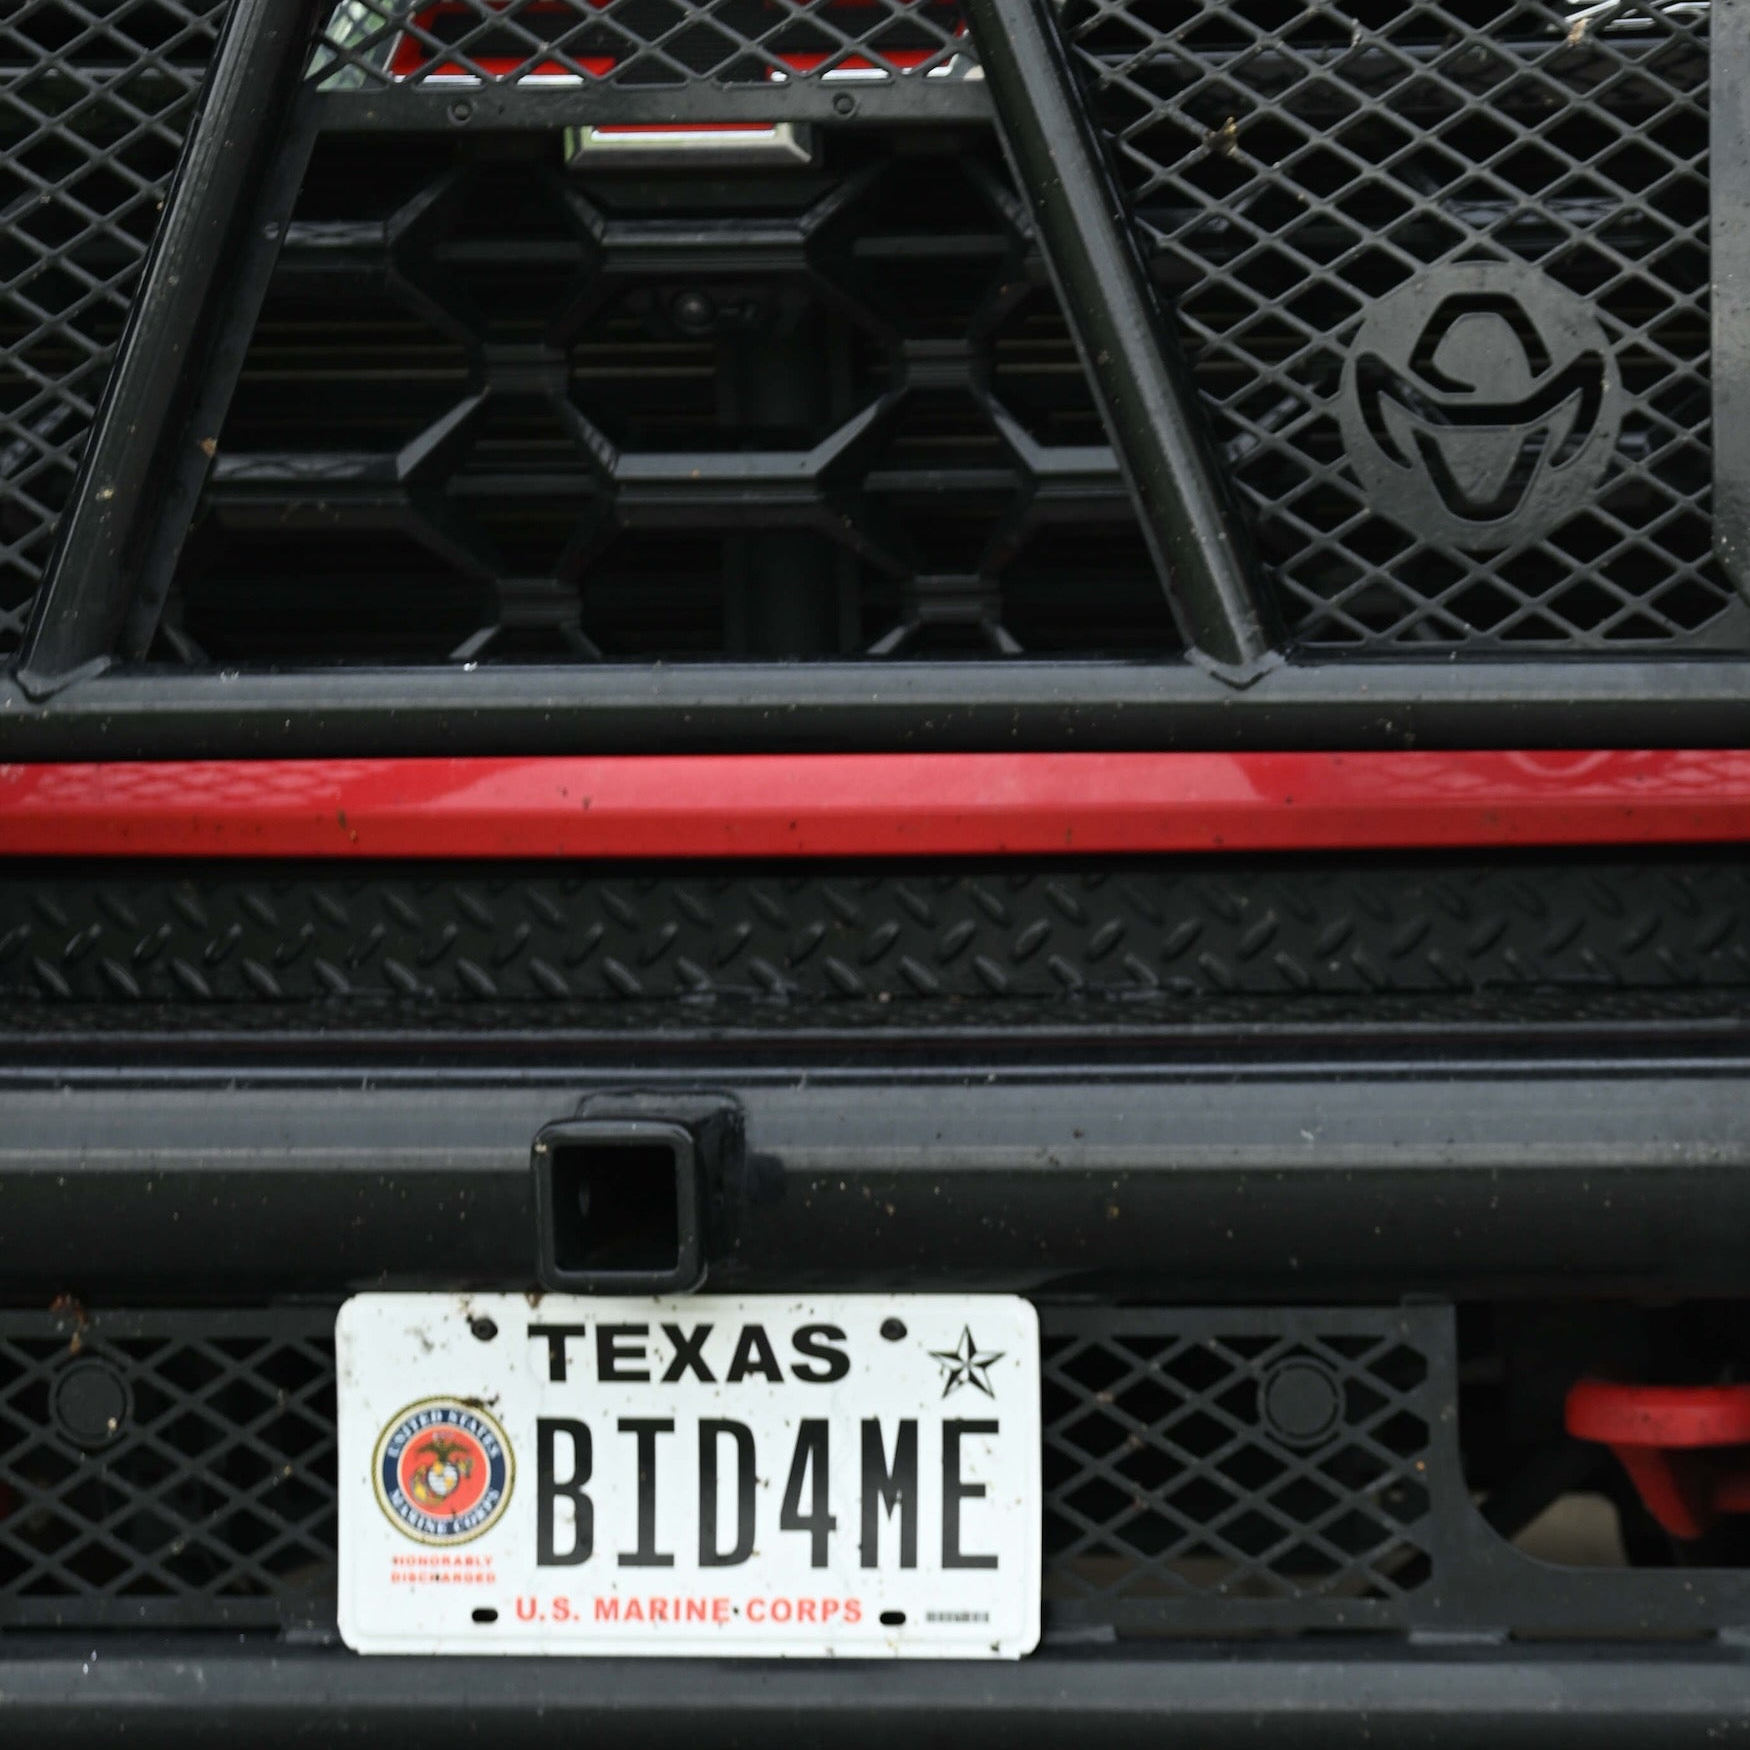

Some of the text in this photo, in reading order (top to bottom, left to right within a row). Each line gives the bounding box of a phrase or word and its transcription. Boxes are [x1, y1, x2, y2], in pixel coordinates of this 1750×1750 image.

[527, 1322, 852, 1383] TEXAS
[388, 1409, 443, 1458] UNITED
[453, 1488, 499, 1533] CORPS
[536, 1417, 999, 1569] BID4ME
[390, 1571, 497, 1584] DISCHARGED
[392, 1554, 493, 1567] HONORABLY
[515, 1597, 863, 1623] U.S. MARINE CORPS
